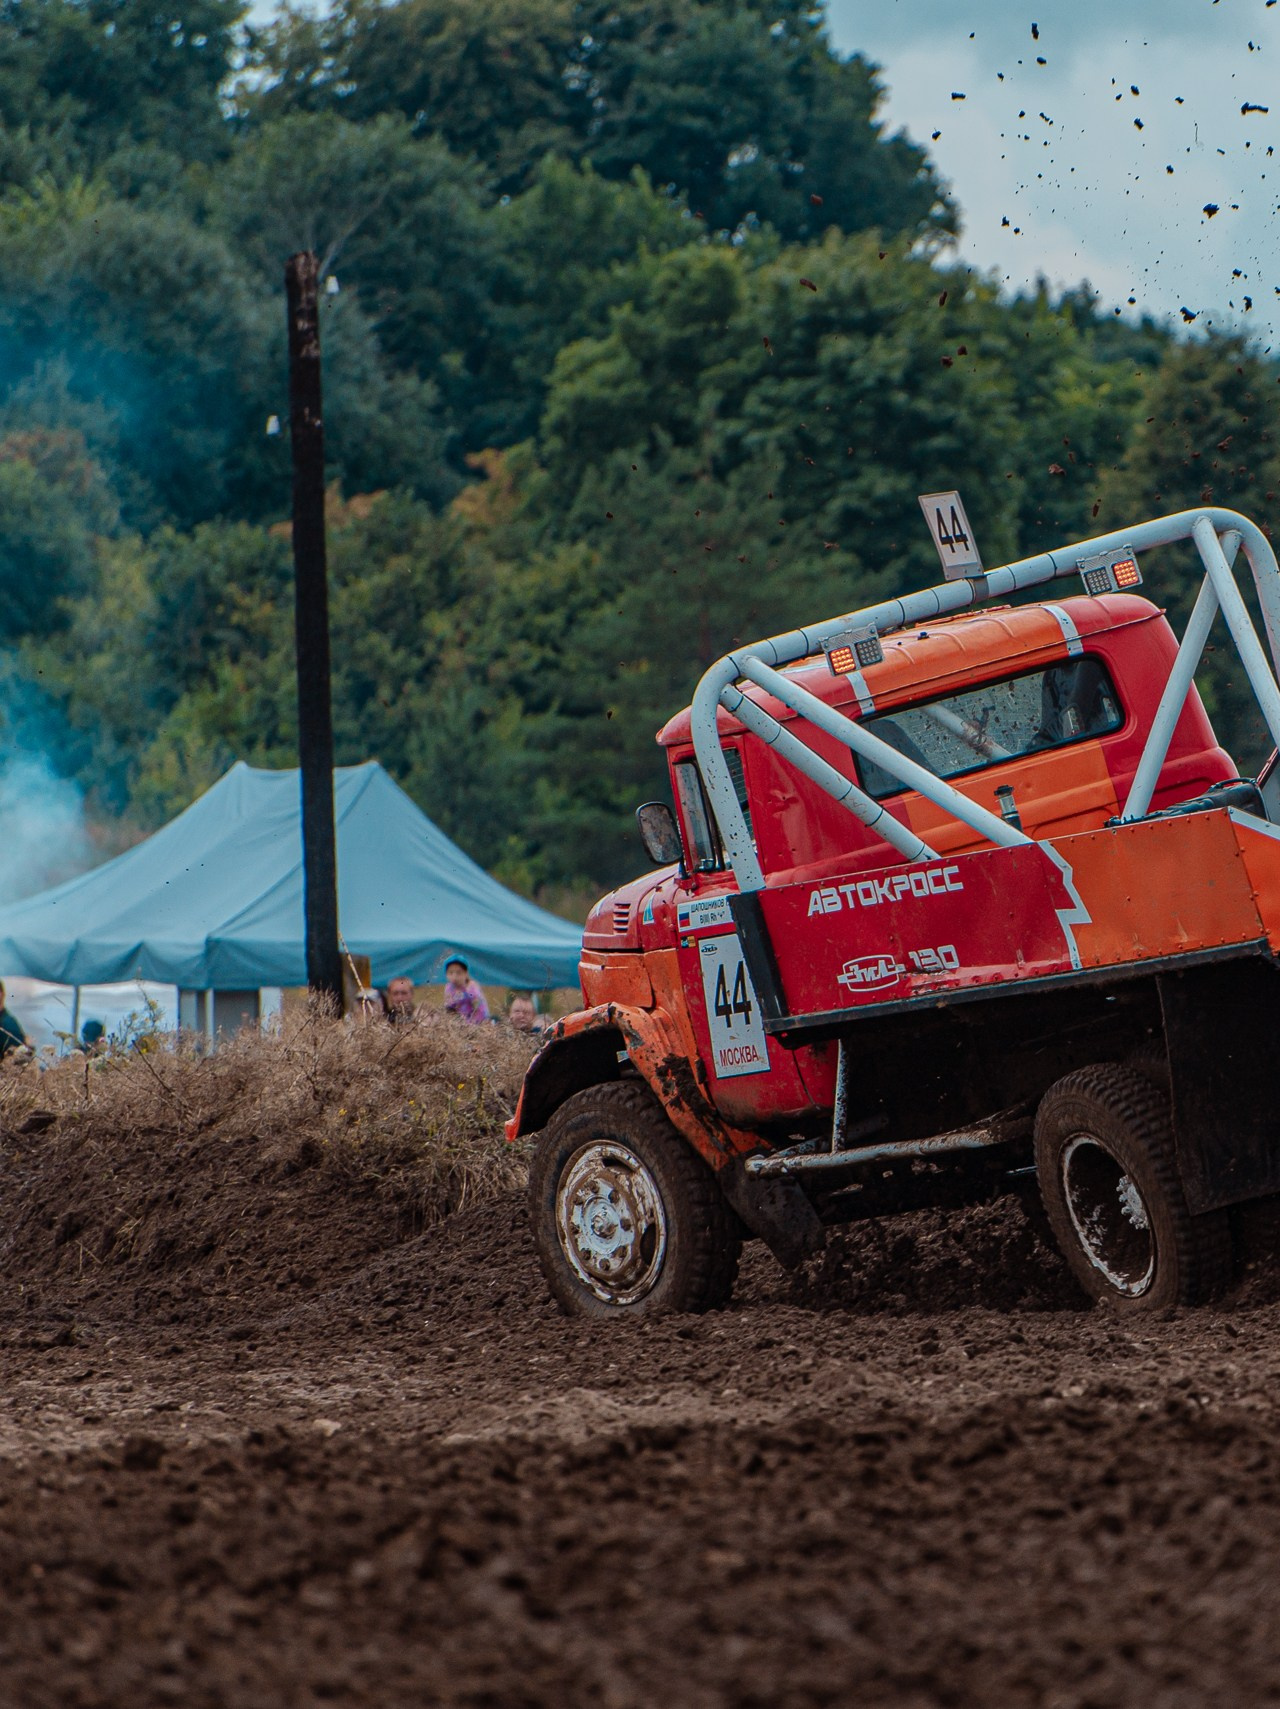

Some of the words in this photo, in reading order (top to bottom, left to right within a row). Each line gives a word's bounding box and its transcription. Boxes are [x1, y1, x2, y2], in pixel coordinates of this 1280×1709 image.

[936, 505, 969, 553] 44
[807, 865, 964, 917] АВТОКРОСС
[908, 945, 960, 971] 130
[715, 961, 751, 1028] 44
[719, 1044, 759, 1067] МОСКВА
